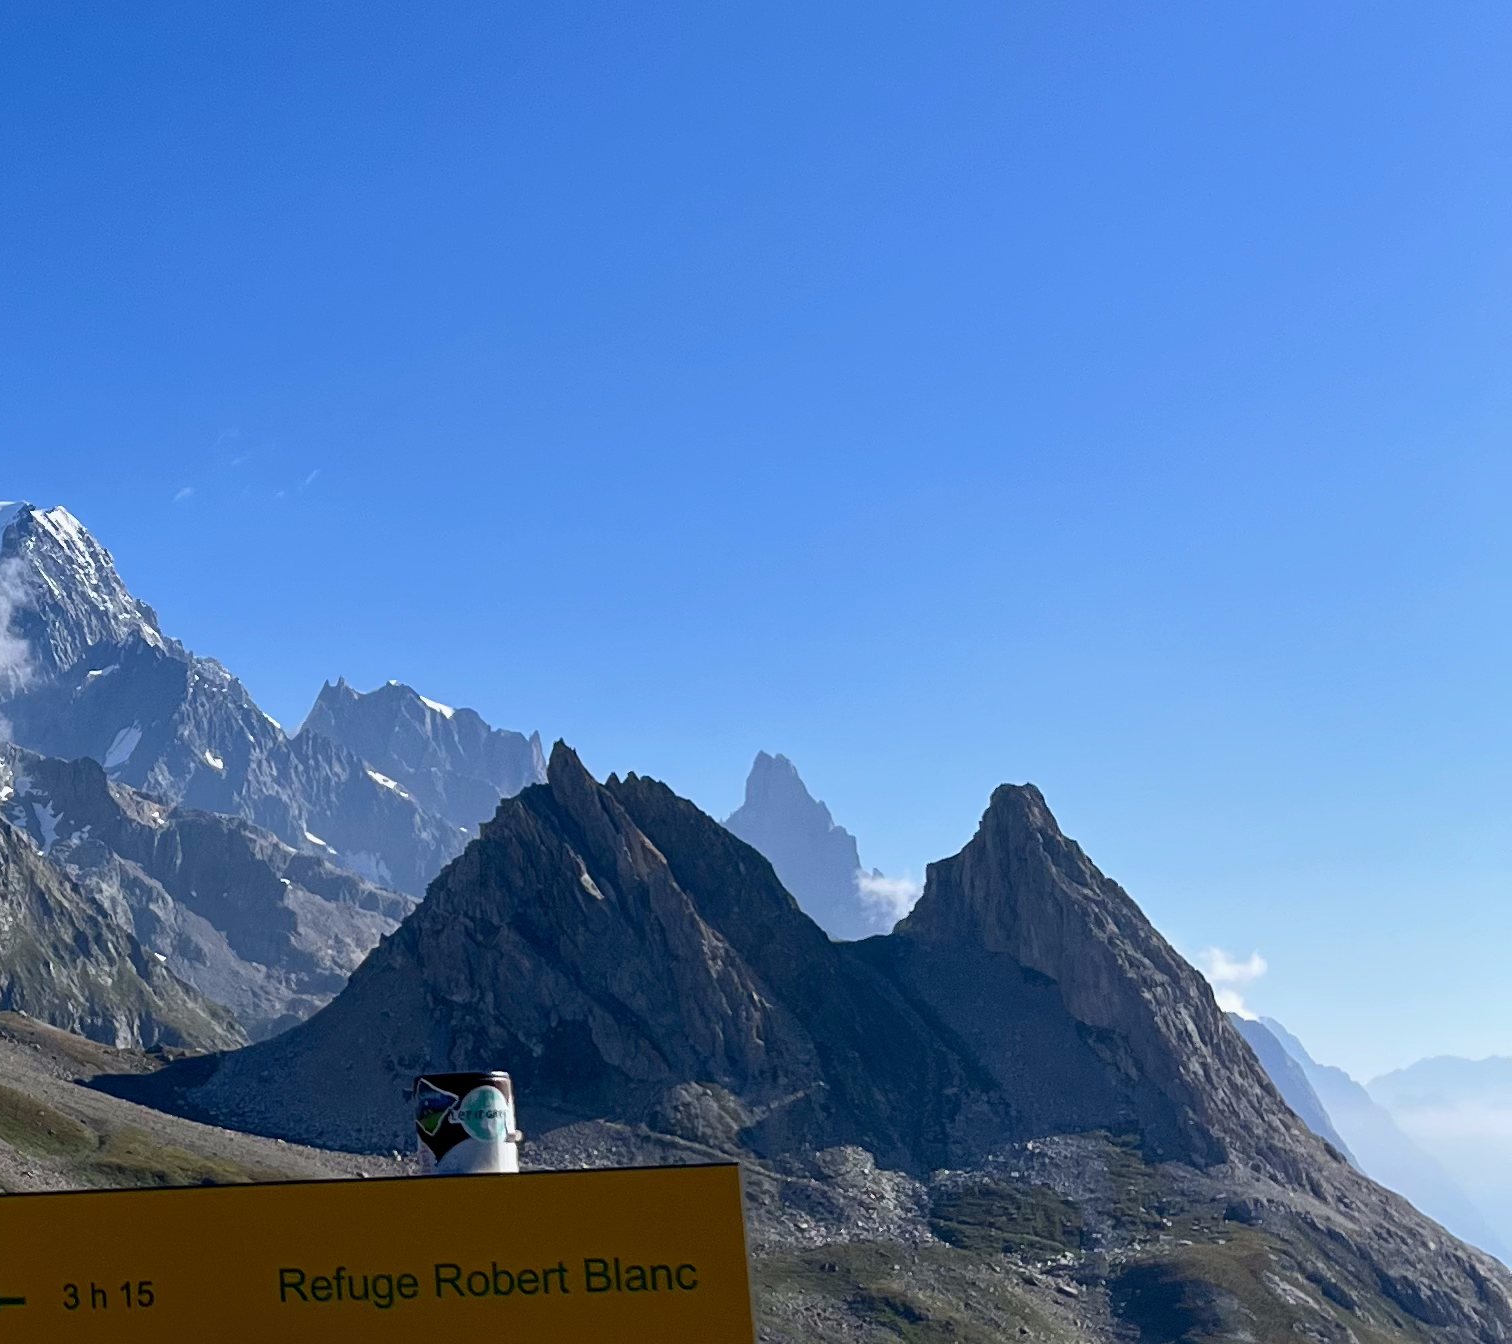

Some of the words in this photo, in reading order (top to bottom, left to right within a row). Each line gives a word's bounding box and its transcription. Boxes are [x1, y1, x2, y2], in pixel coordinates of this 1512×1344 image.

[63, 1283, 79, 1310] 3
[90, 1282, 107, 1309] h
[120, 1281, 155, 1308] 15
[278, 1266, 419, 1309] Refuge
[434, 1260, 570, 1298] Robert
[583, 1257, 699, 1293] Blanc
